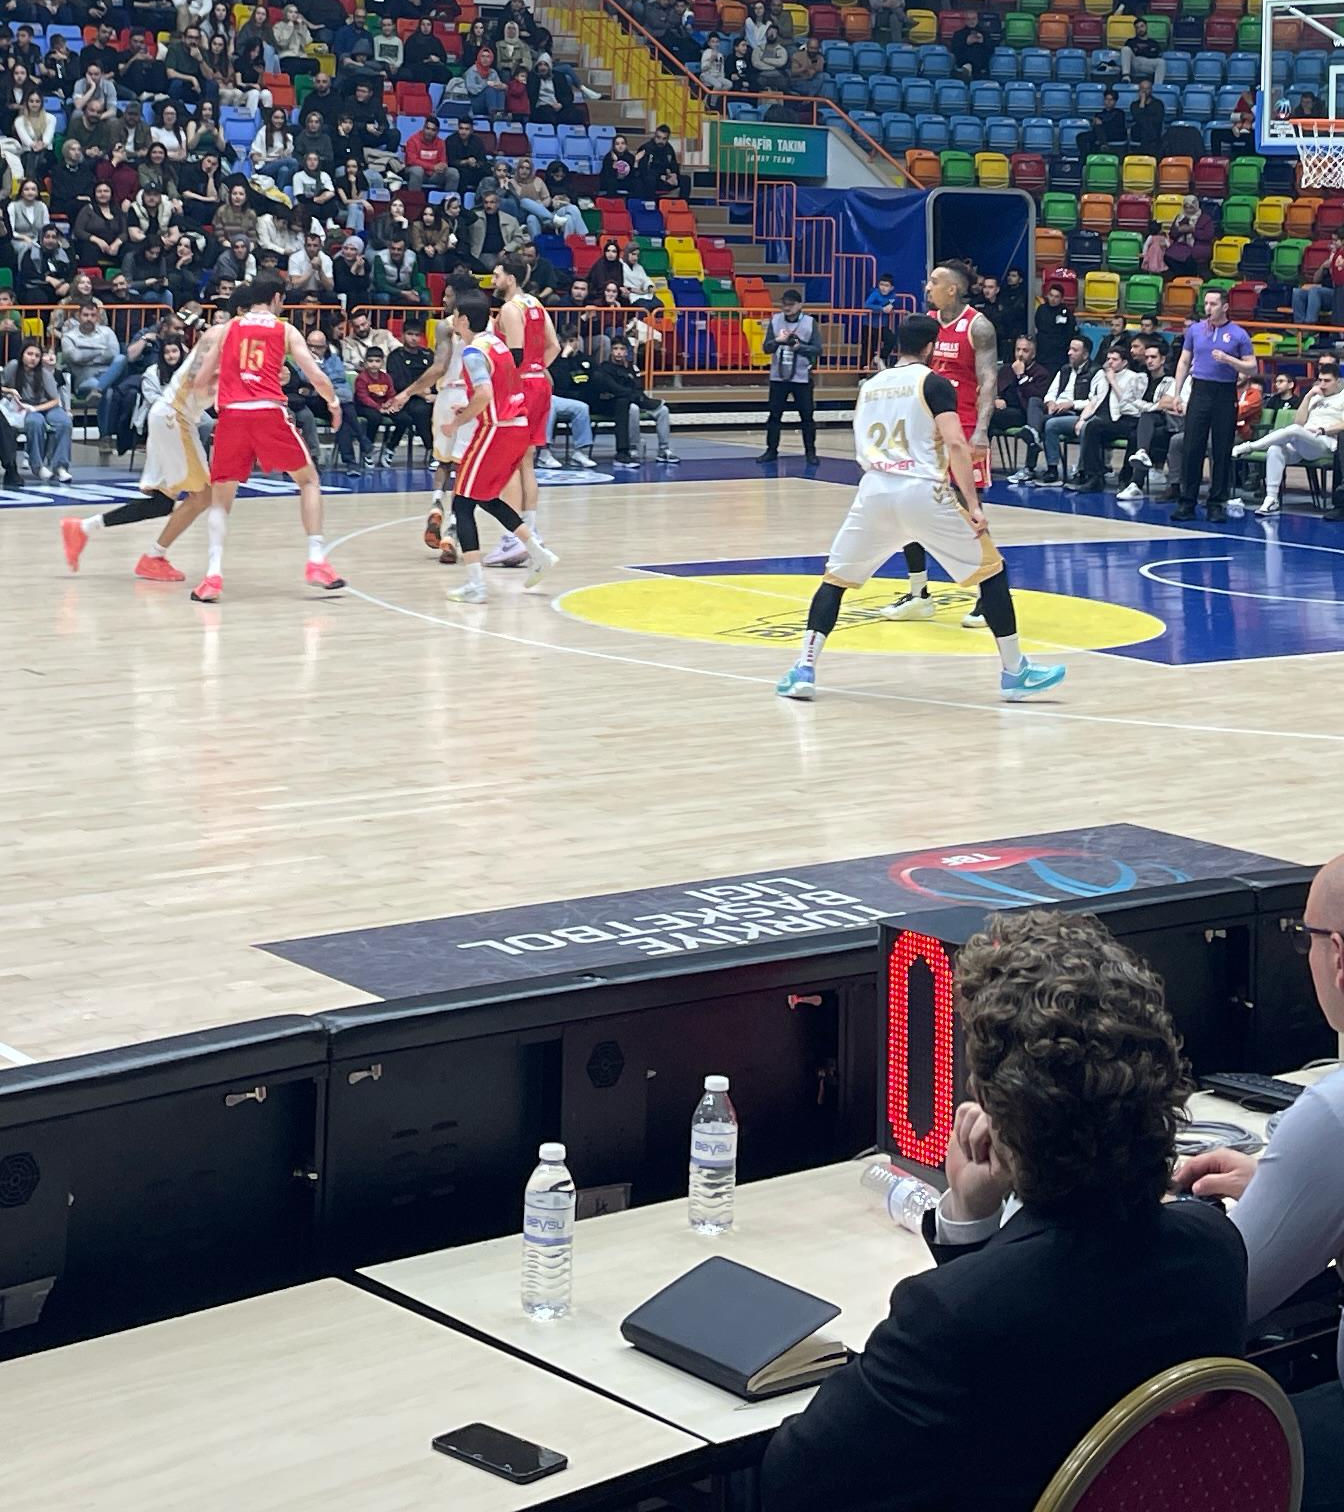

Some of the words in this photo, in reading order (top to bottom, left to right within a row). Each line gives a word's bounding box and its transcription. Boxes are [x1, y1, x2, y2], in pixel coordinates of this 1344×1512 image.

[777, 139, 806, 153] TAKIM
[239, 337, 267, 372] 15
[864, 384, 916, 403] METEHAN
[866, 418, 910, 454] 24
[457, 888, 864, 958] BASKETBOL
[619, 905, 907, 956] TÜRKİYE
